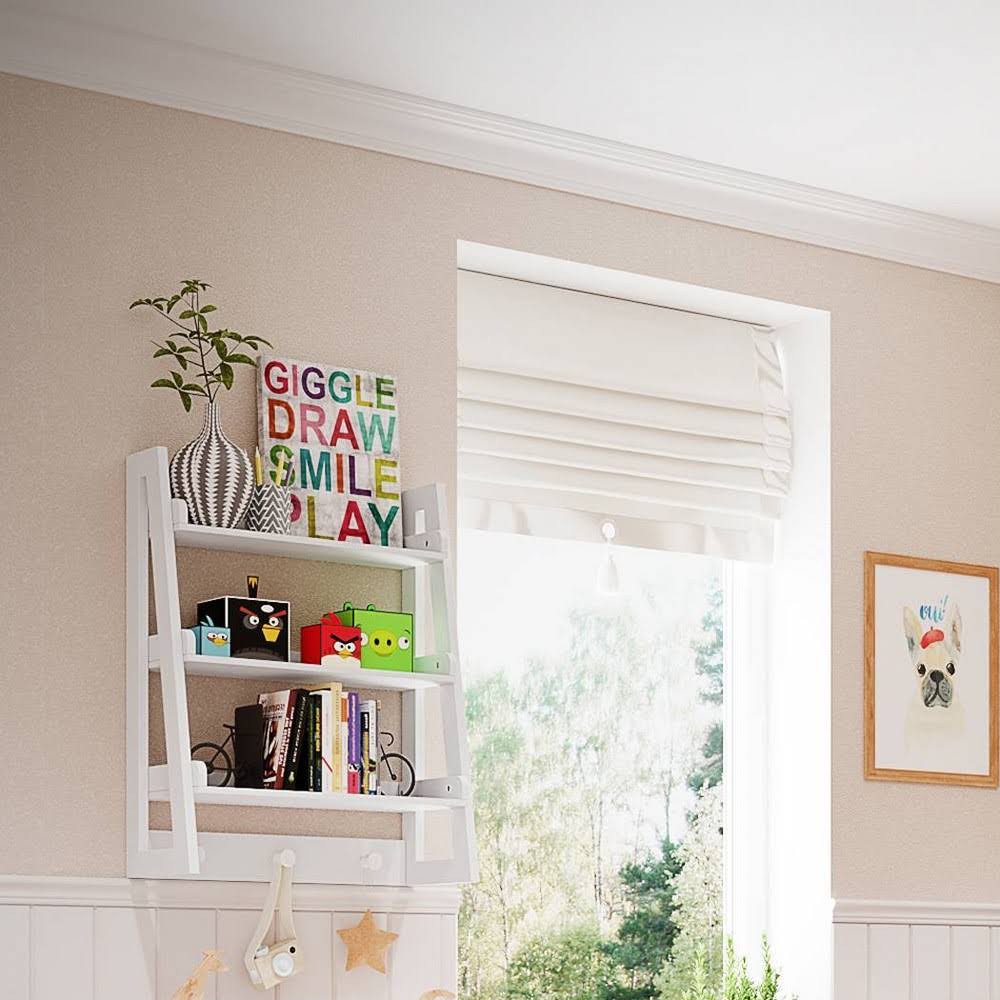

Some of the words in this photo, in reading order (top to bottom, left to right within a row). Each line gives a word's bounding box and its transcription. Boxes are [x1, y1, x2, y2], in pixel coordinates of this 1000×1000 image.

[264, 360, 396, 411] GIGGLE
[267, 398, 396, 454] DRAW
[269, 444, 400, 500] SMILE
